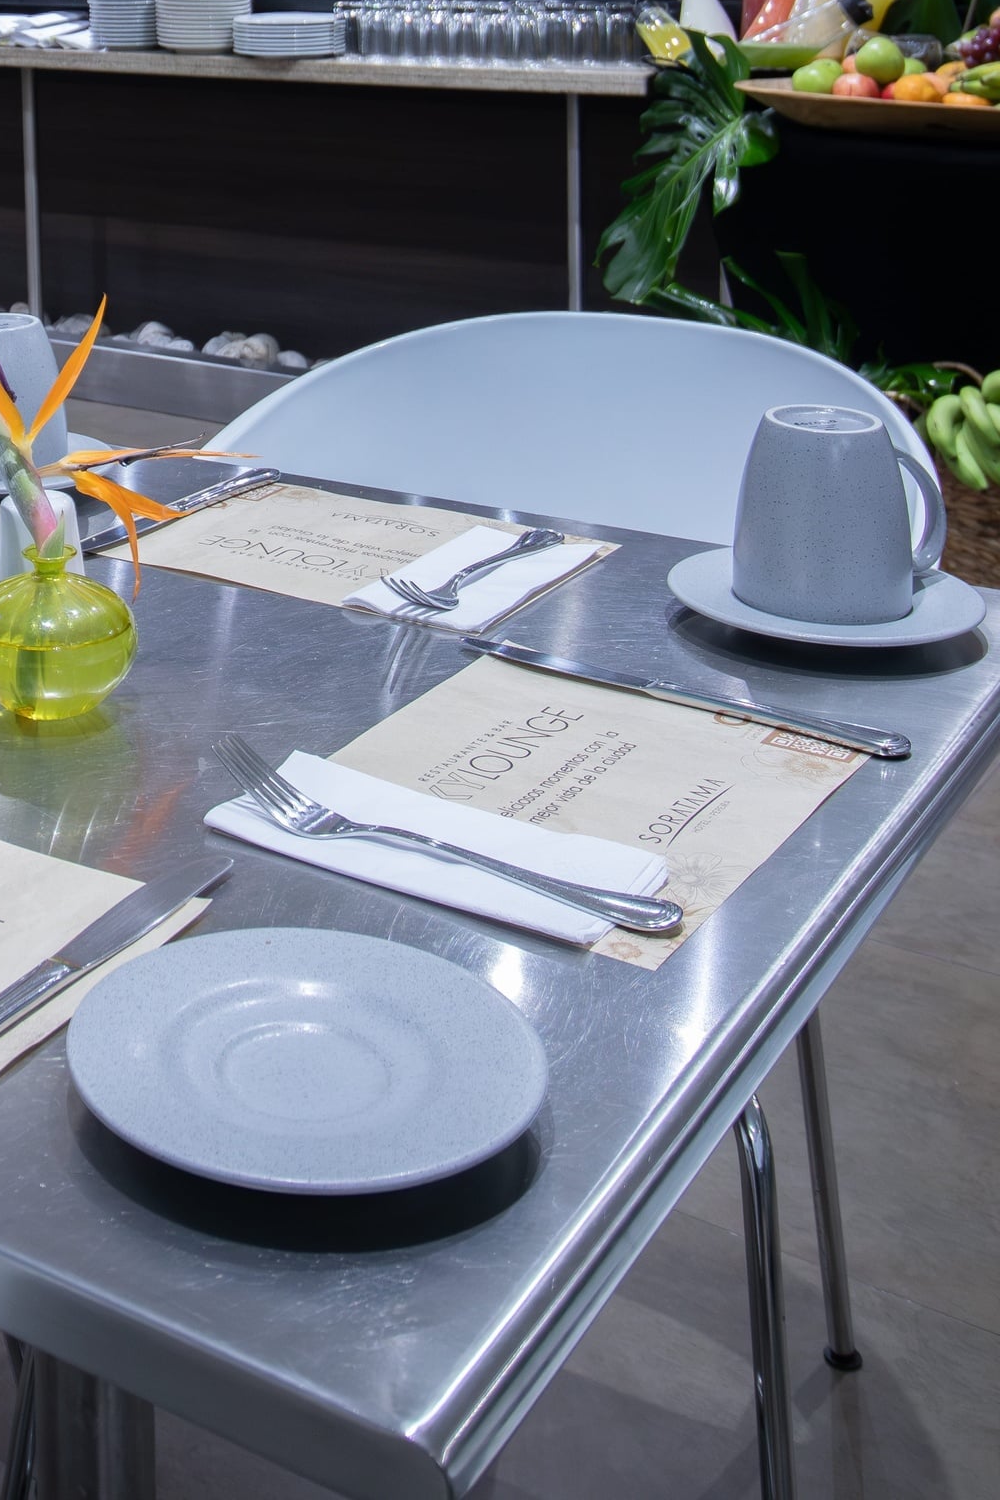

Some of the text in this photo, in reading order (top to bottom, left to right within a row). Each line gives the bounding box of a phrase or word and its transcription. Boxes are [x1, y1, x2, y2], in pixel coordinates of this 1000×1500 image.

[332, 512, 440, 537] SORATAMA
[417, 736, 487, 782] RESTAURANTE
[491, 719, 513, 733] BAR
[500, 729, 619, 819] eliciosos momentos con la
[529, 802, 563, 825] mejor
[557, 784, 583, 803] vista
[578, 772, 597, 786] de
[602, 740, 637, 766] ciudad
[638, 778, 727, 844] SORATAMA
